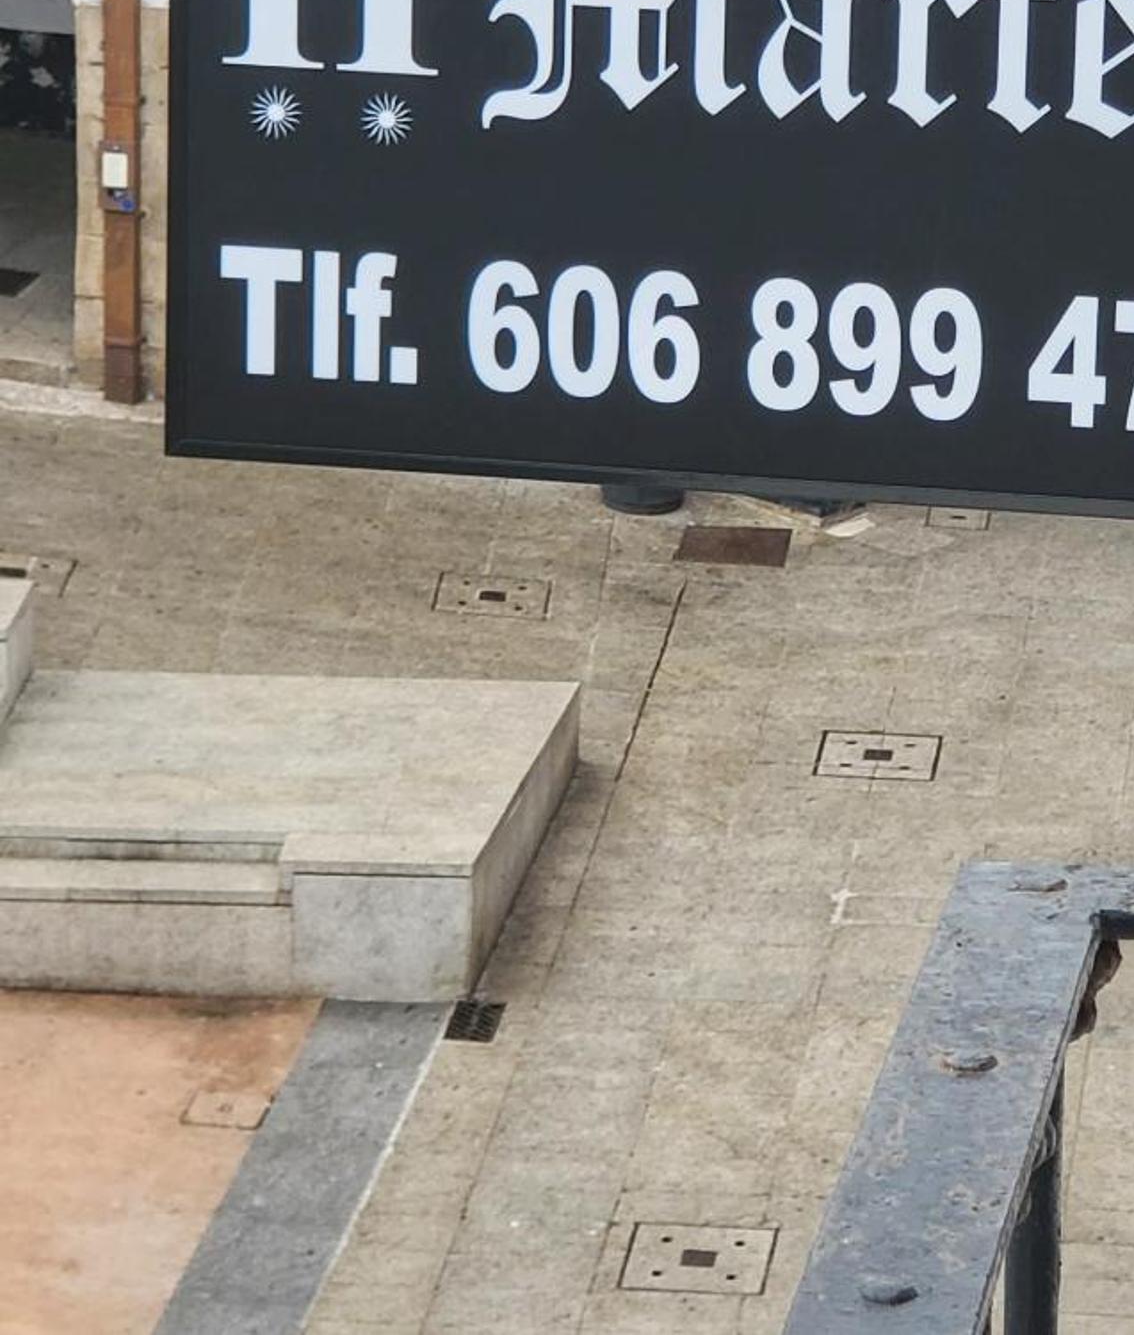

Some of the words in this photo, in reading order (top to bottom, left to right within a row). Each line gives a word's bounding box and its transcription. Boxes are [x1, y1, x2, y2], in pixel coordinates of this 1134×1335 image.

[220, 244, 418, 385] Tlf.
[467, 259, 701, 404] 606
[747, 277, 983, 421] 899
